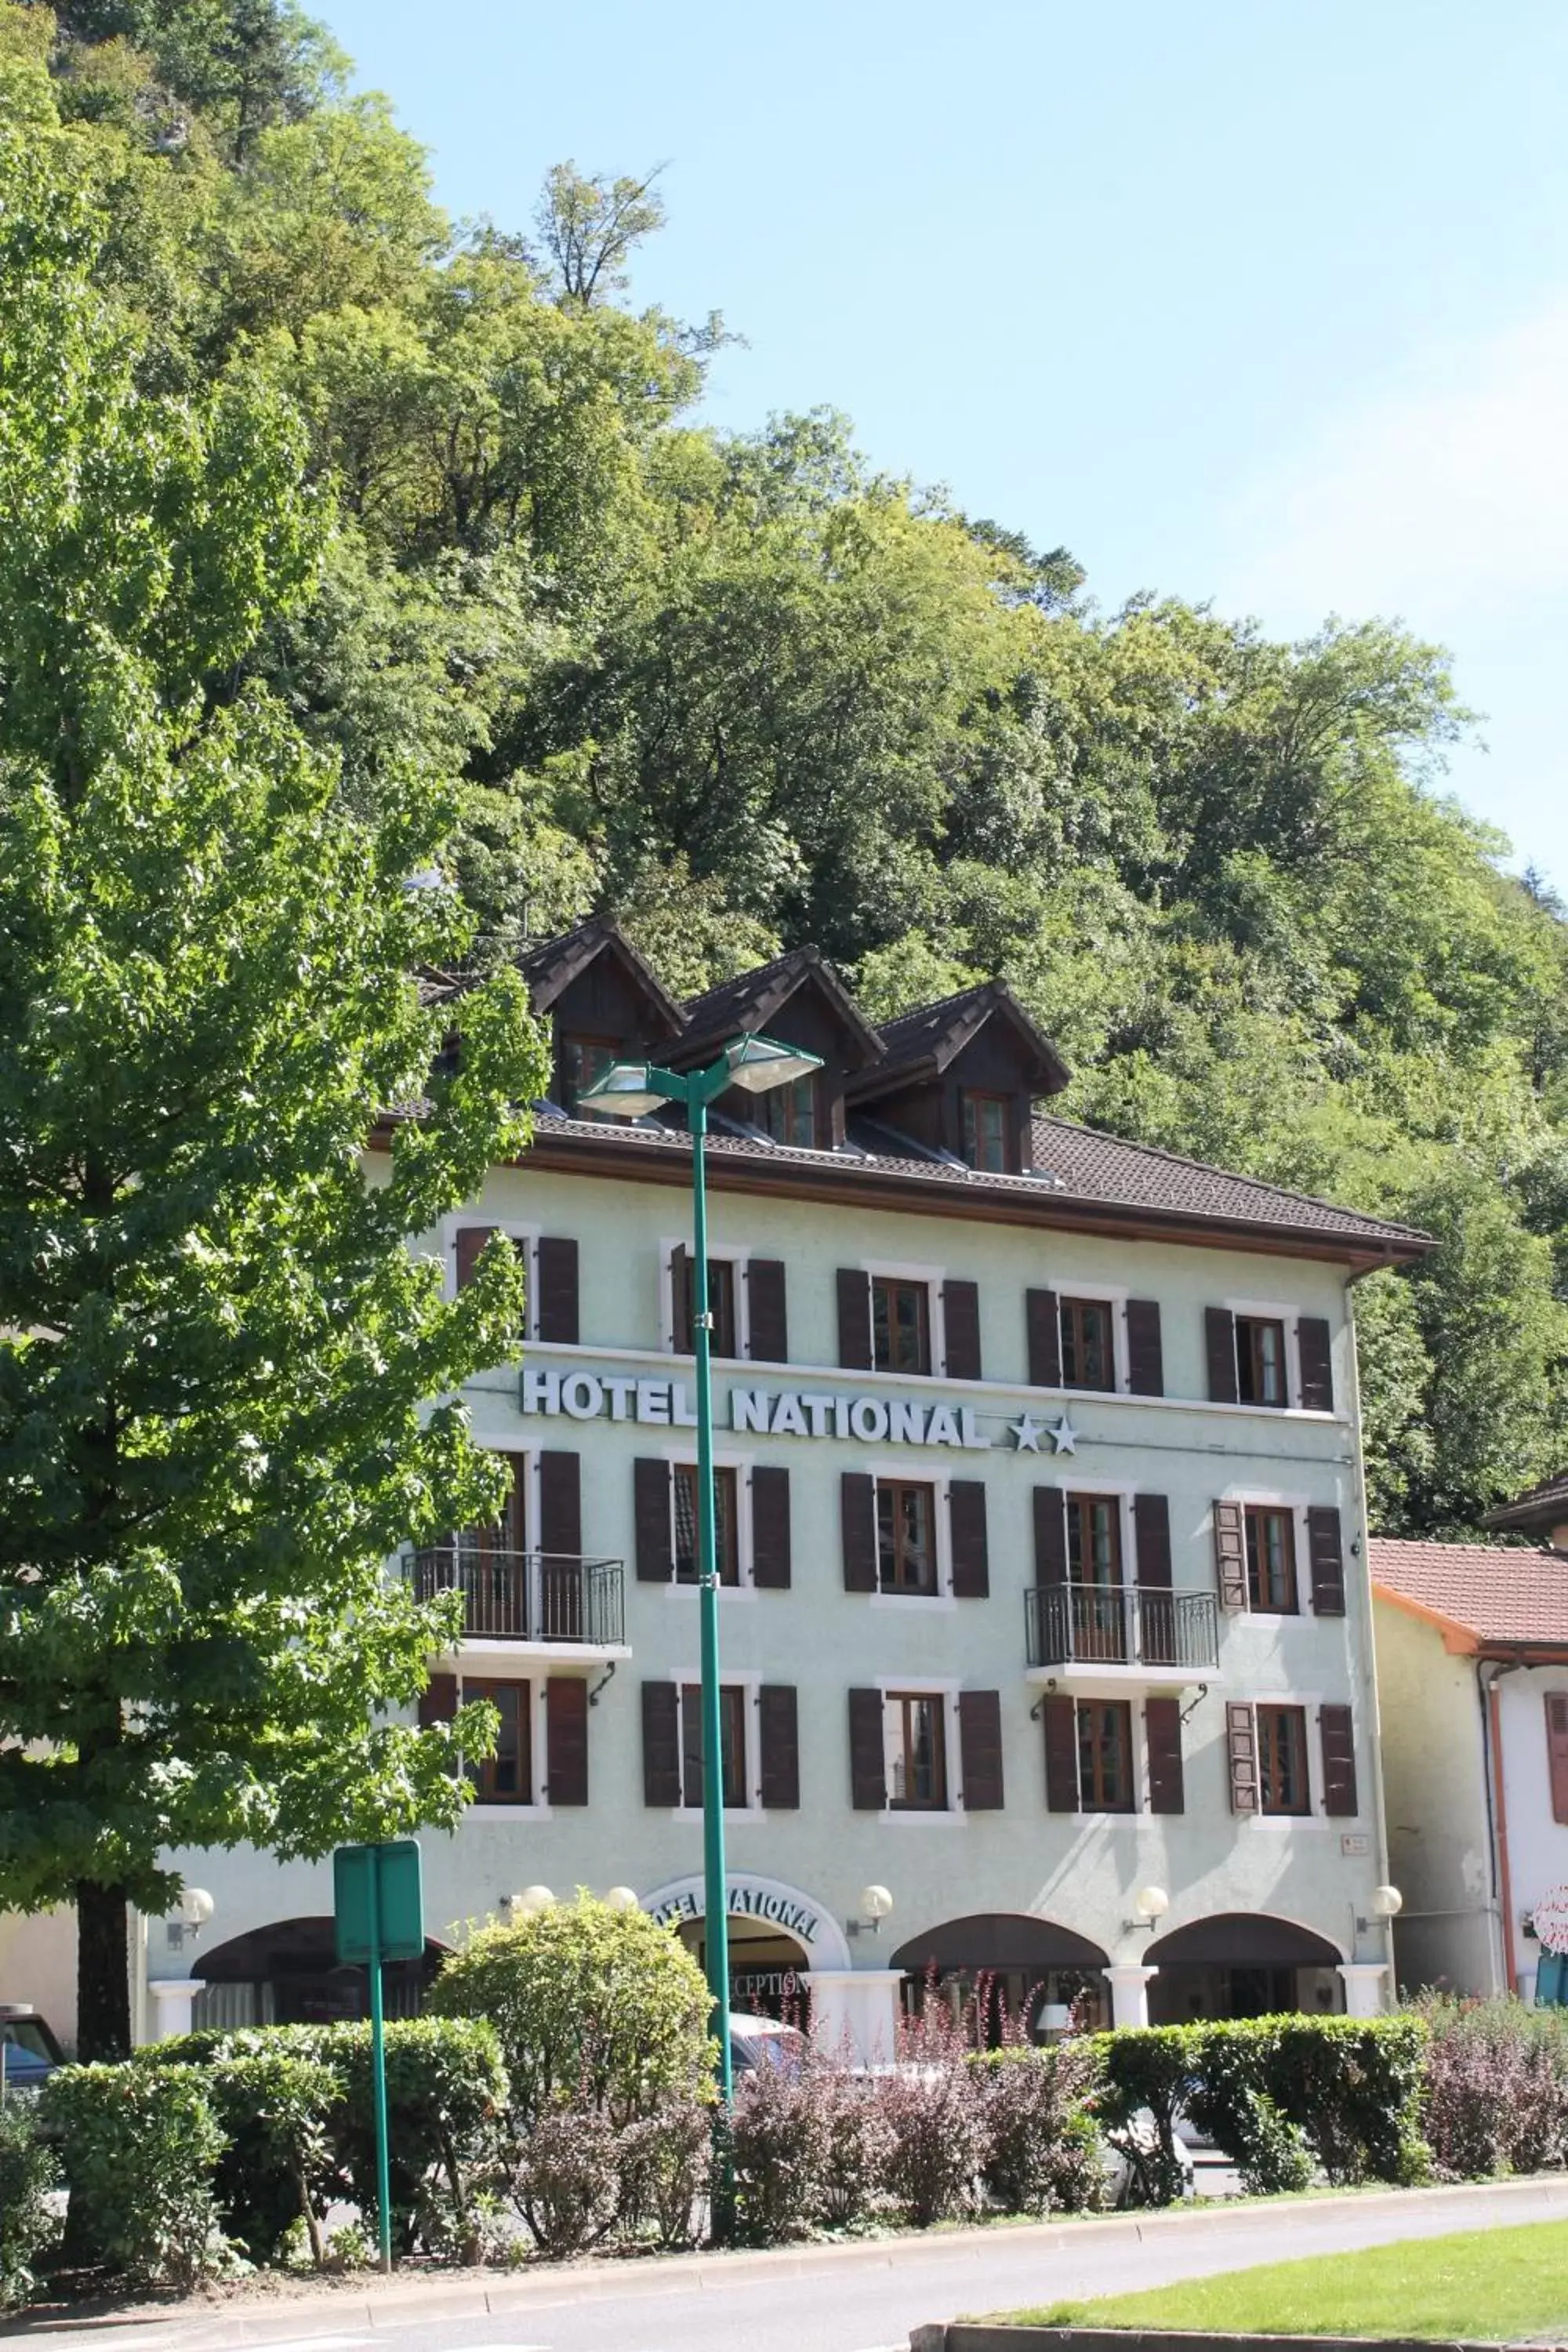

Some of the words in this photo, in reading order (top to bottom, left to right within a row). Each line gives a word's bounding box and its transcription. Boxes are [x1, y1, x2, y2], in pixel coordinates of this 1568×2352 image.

[521, 1370, 699, 1427] HOTEL
[729, 1388, 991, 1449] NATIONAL
[650, 1893, 705, 1929] OTEL
